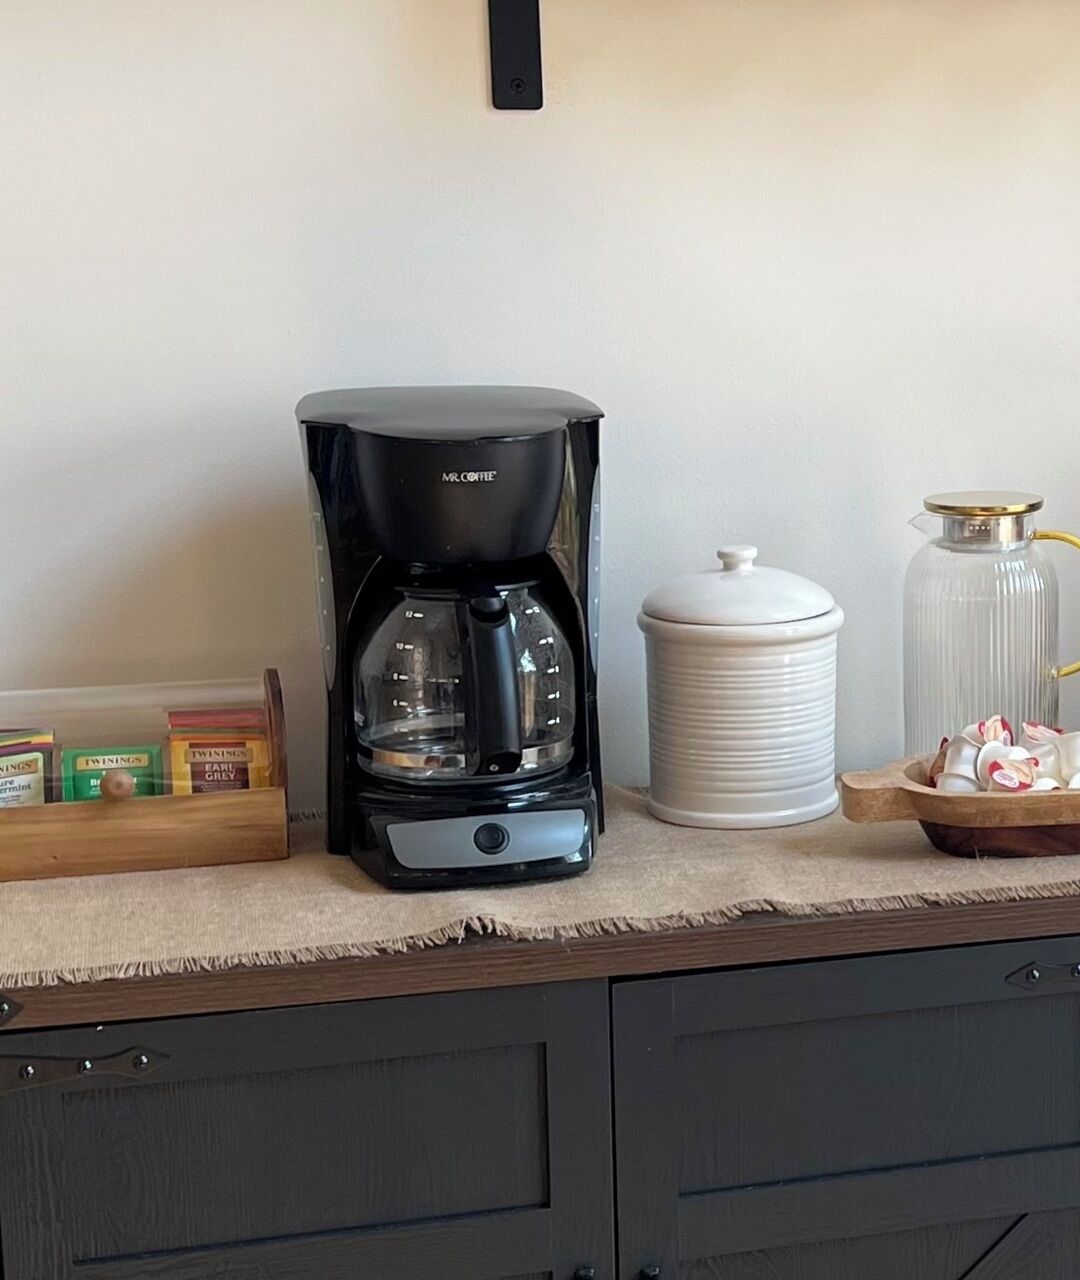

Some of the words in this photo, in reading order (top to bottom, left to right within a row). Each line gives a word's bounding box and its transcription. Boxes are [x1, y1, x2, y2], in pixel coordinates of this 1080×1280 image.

[192, 750, 247, 759] TWININGS
[84, 756, 143, 767] TWININGS
[205, 763, 235, 772] EARL
[205, 771, 236, 781] GREY
